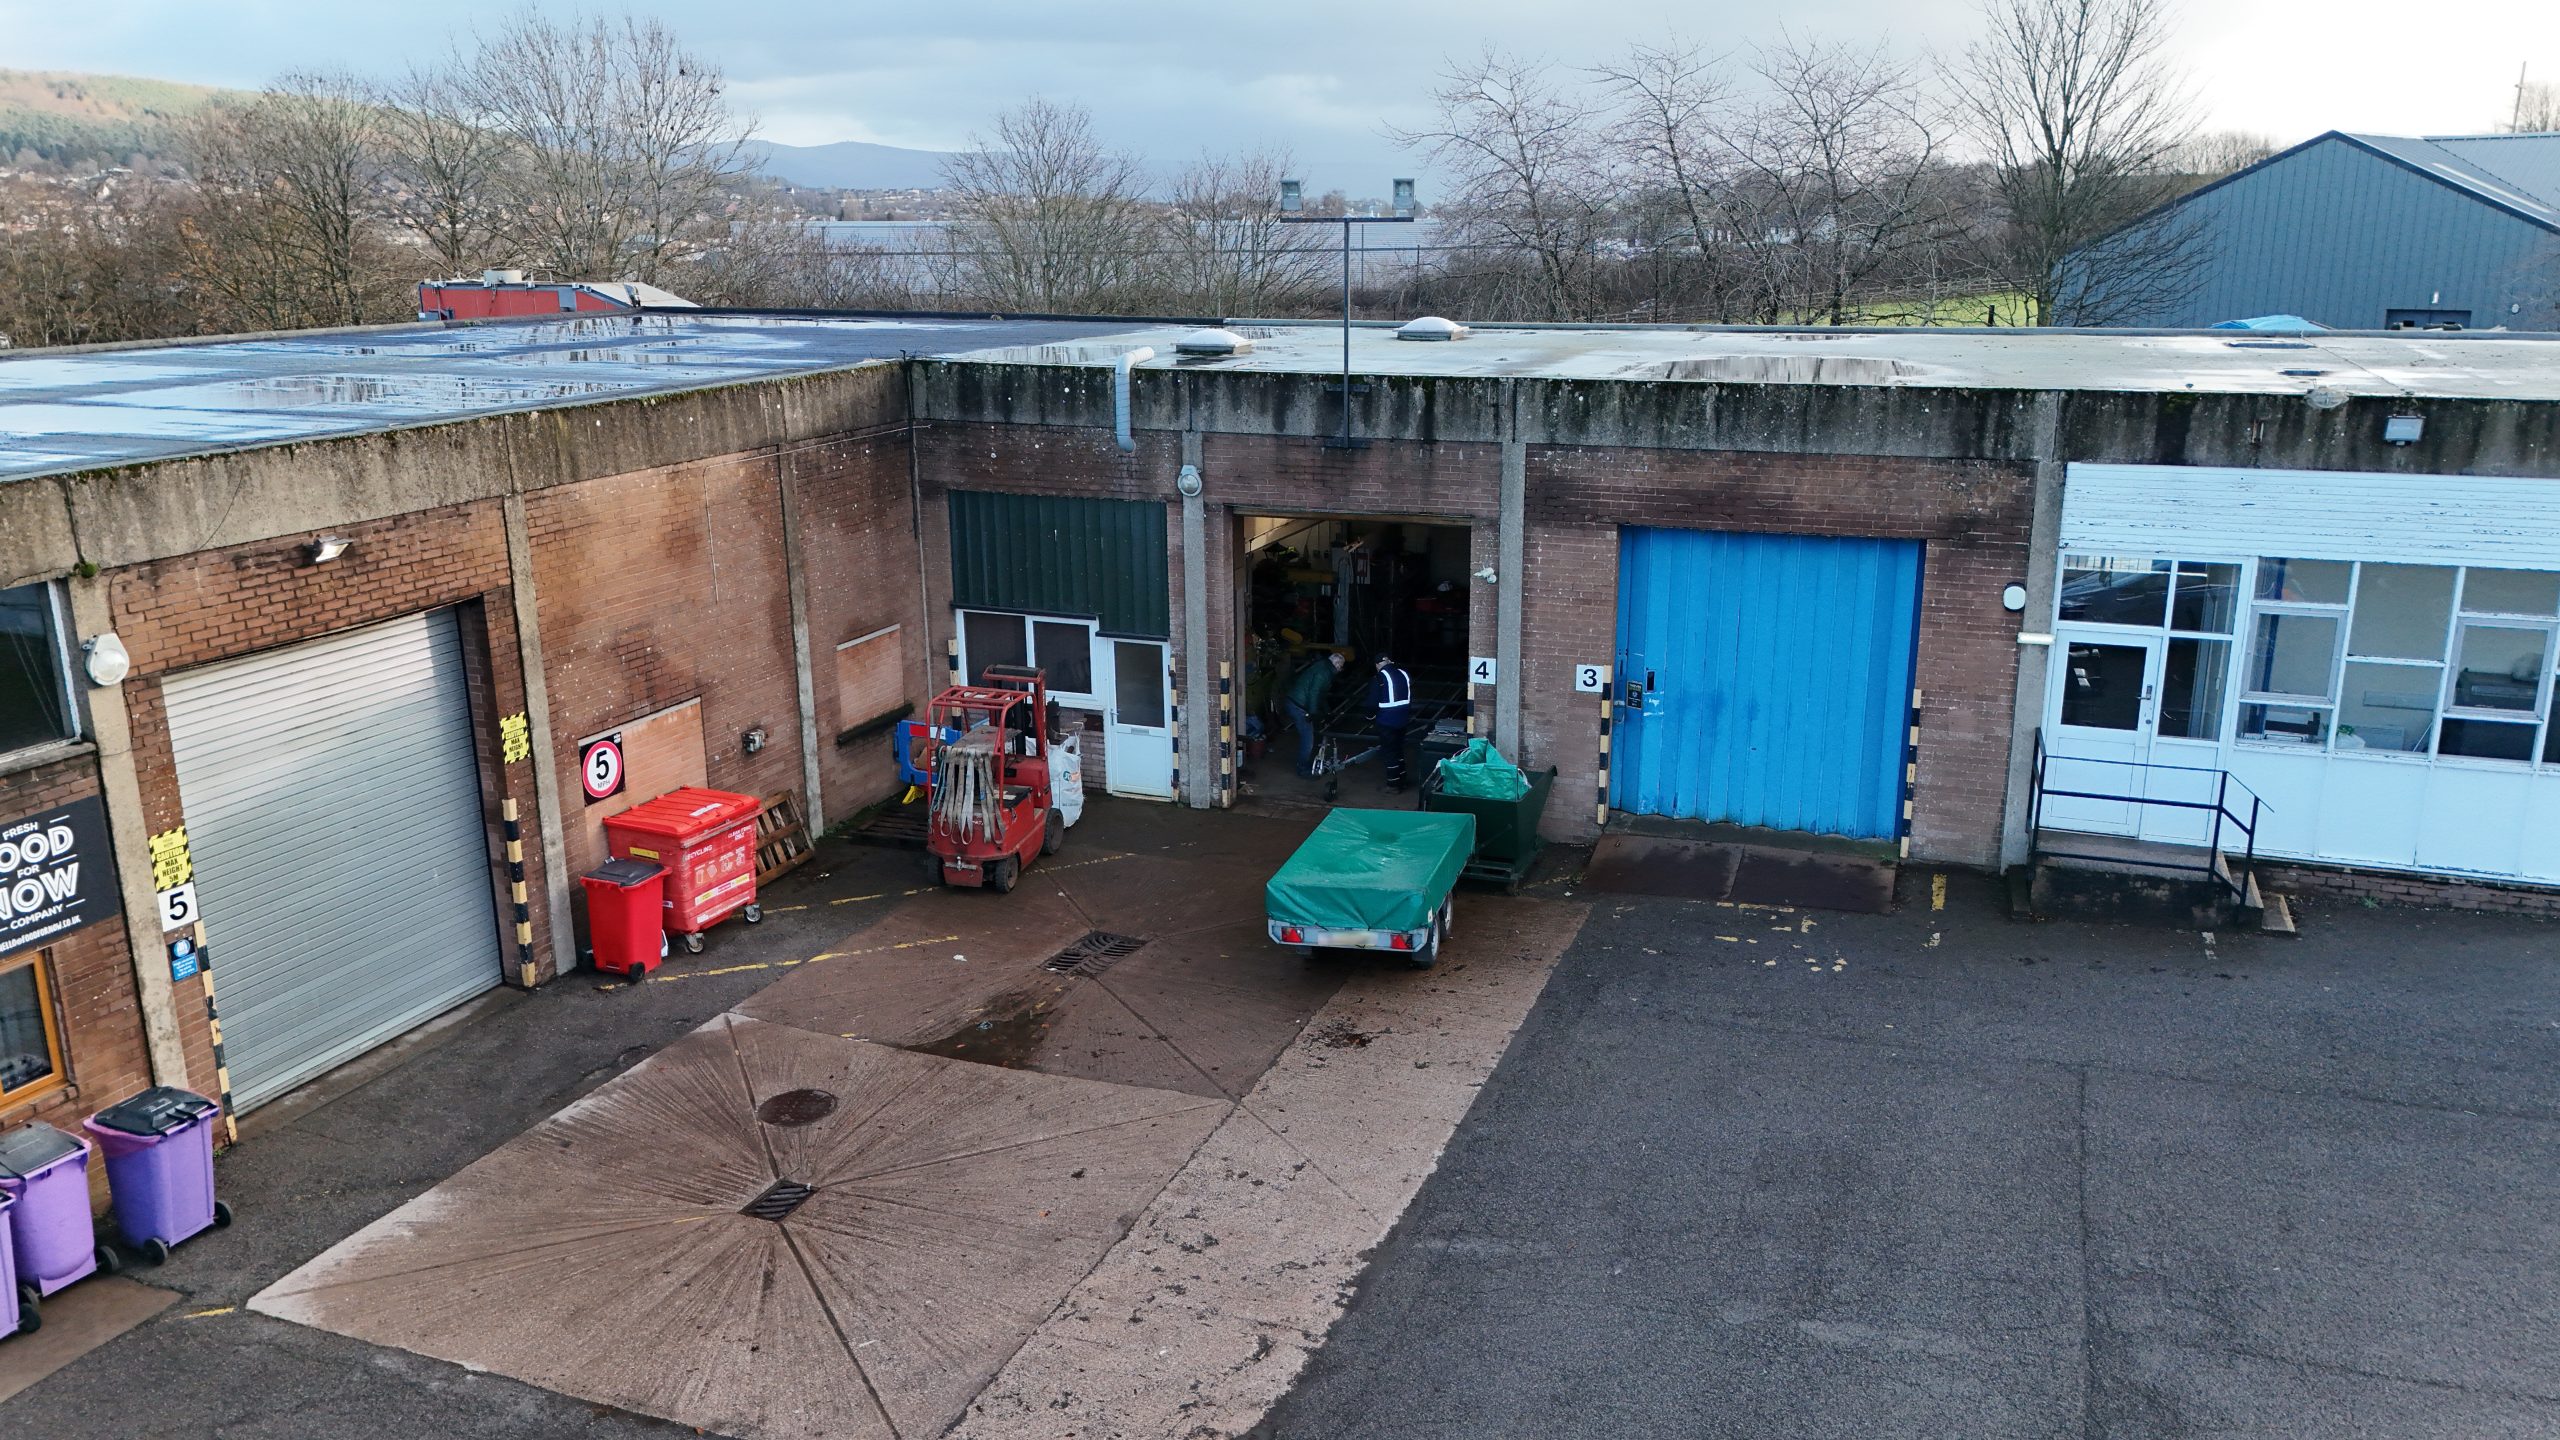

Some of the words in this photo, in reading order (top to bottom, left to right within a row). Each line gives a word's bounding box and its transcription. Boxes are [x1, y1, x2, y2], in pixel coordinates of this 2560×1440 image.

[1474, 661, 1489, 679] 4
[1582, 668, 1597, 687] 3
[596, 749, 609, 780] 5
[597, 780, 610, 789] MPH
[2, 822, 38, 840] FRESH
[0, 825, 74, 873] OOD
[17, 864, 40, 879] FOR
[162, 863, 183, 877] HEIGHT
[164, 858, 178, 868] MAX
[169, 873, 179, 882] 5M
[169, 890, 188, 921] 5
[10, 904, 63, 930] COMPANY
